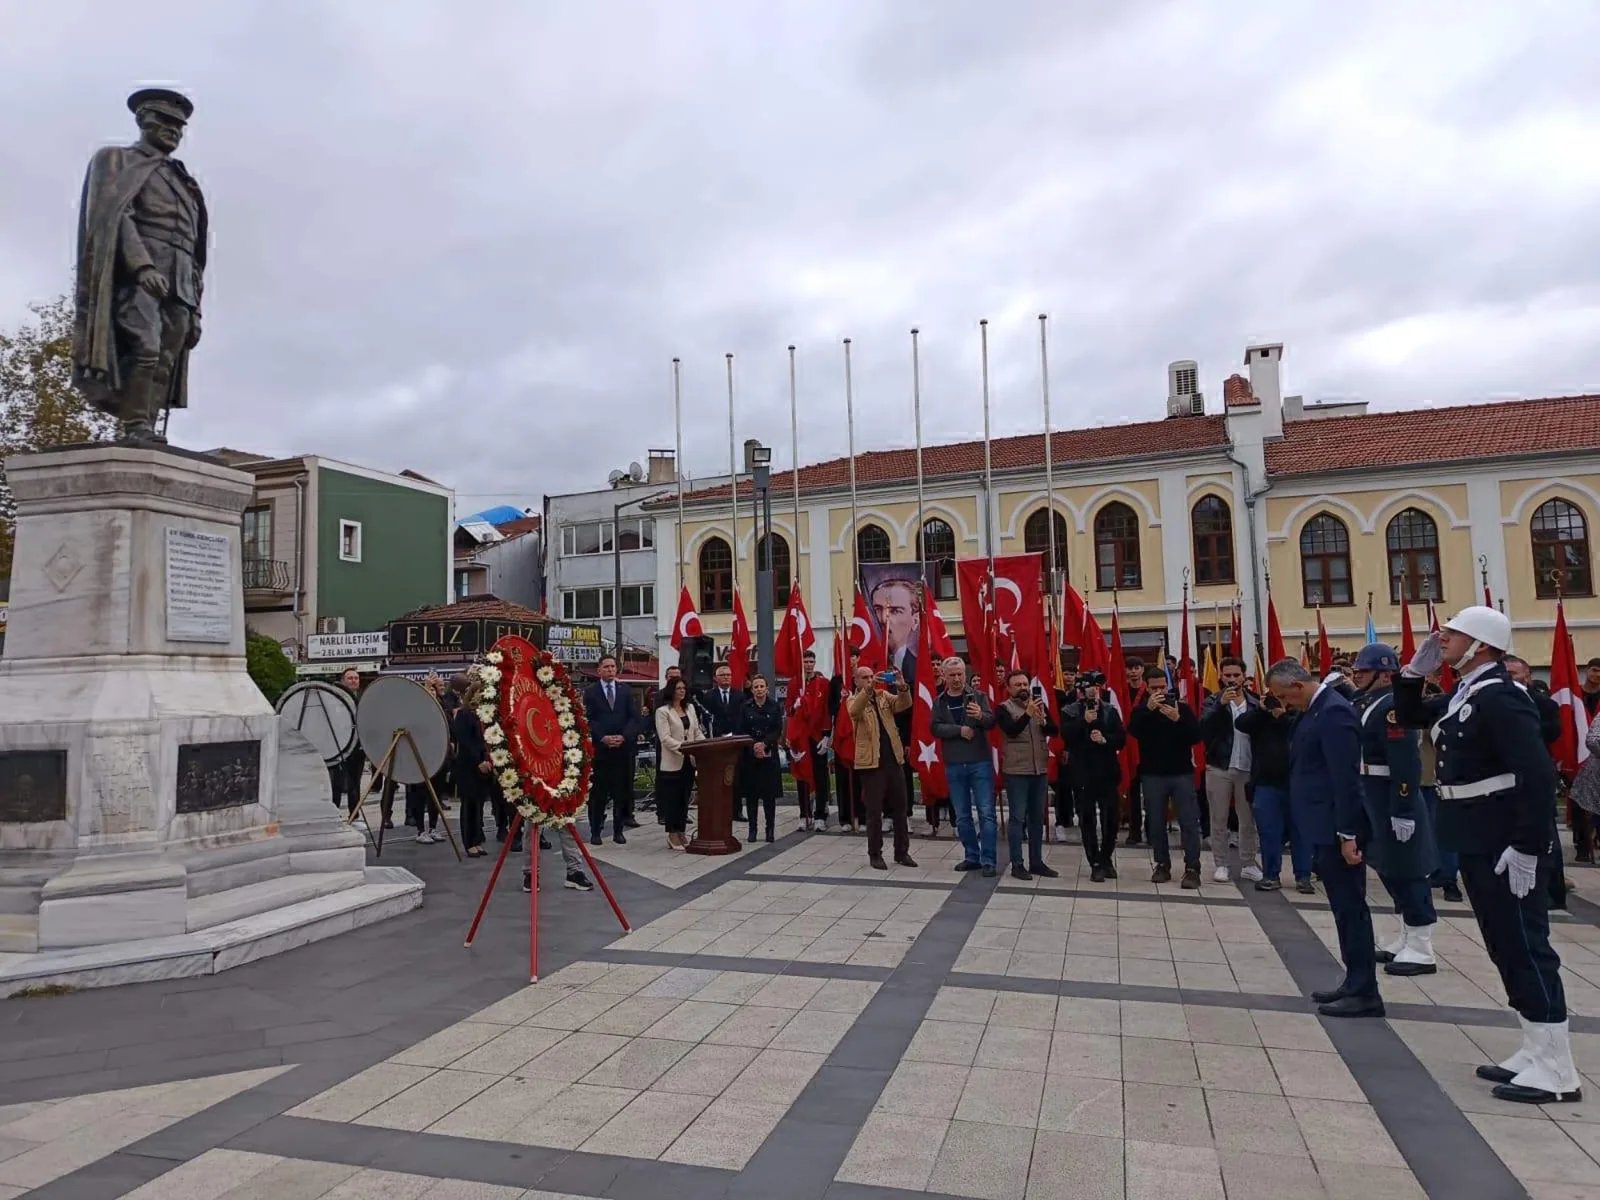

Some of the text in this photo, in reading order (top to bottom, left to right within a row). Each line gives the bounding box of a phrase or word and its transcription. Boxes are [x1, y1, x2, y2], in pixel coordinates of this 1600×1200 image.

[319, 633, 380, 646] NARLI İLETİŞİM
[406, 623, 463, 646] ELİZ
[548, 624, 600, 642] GÜVEN TİCARET
